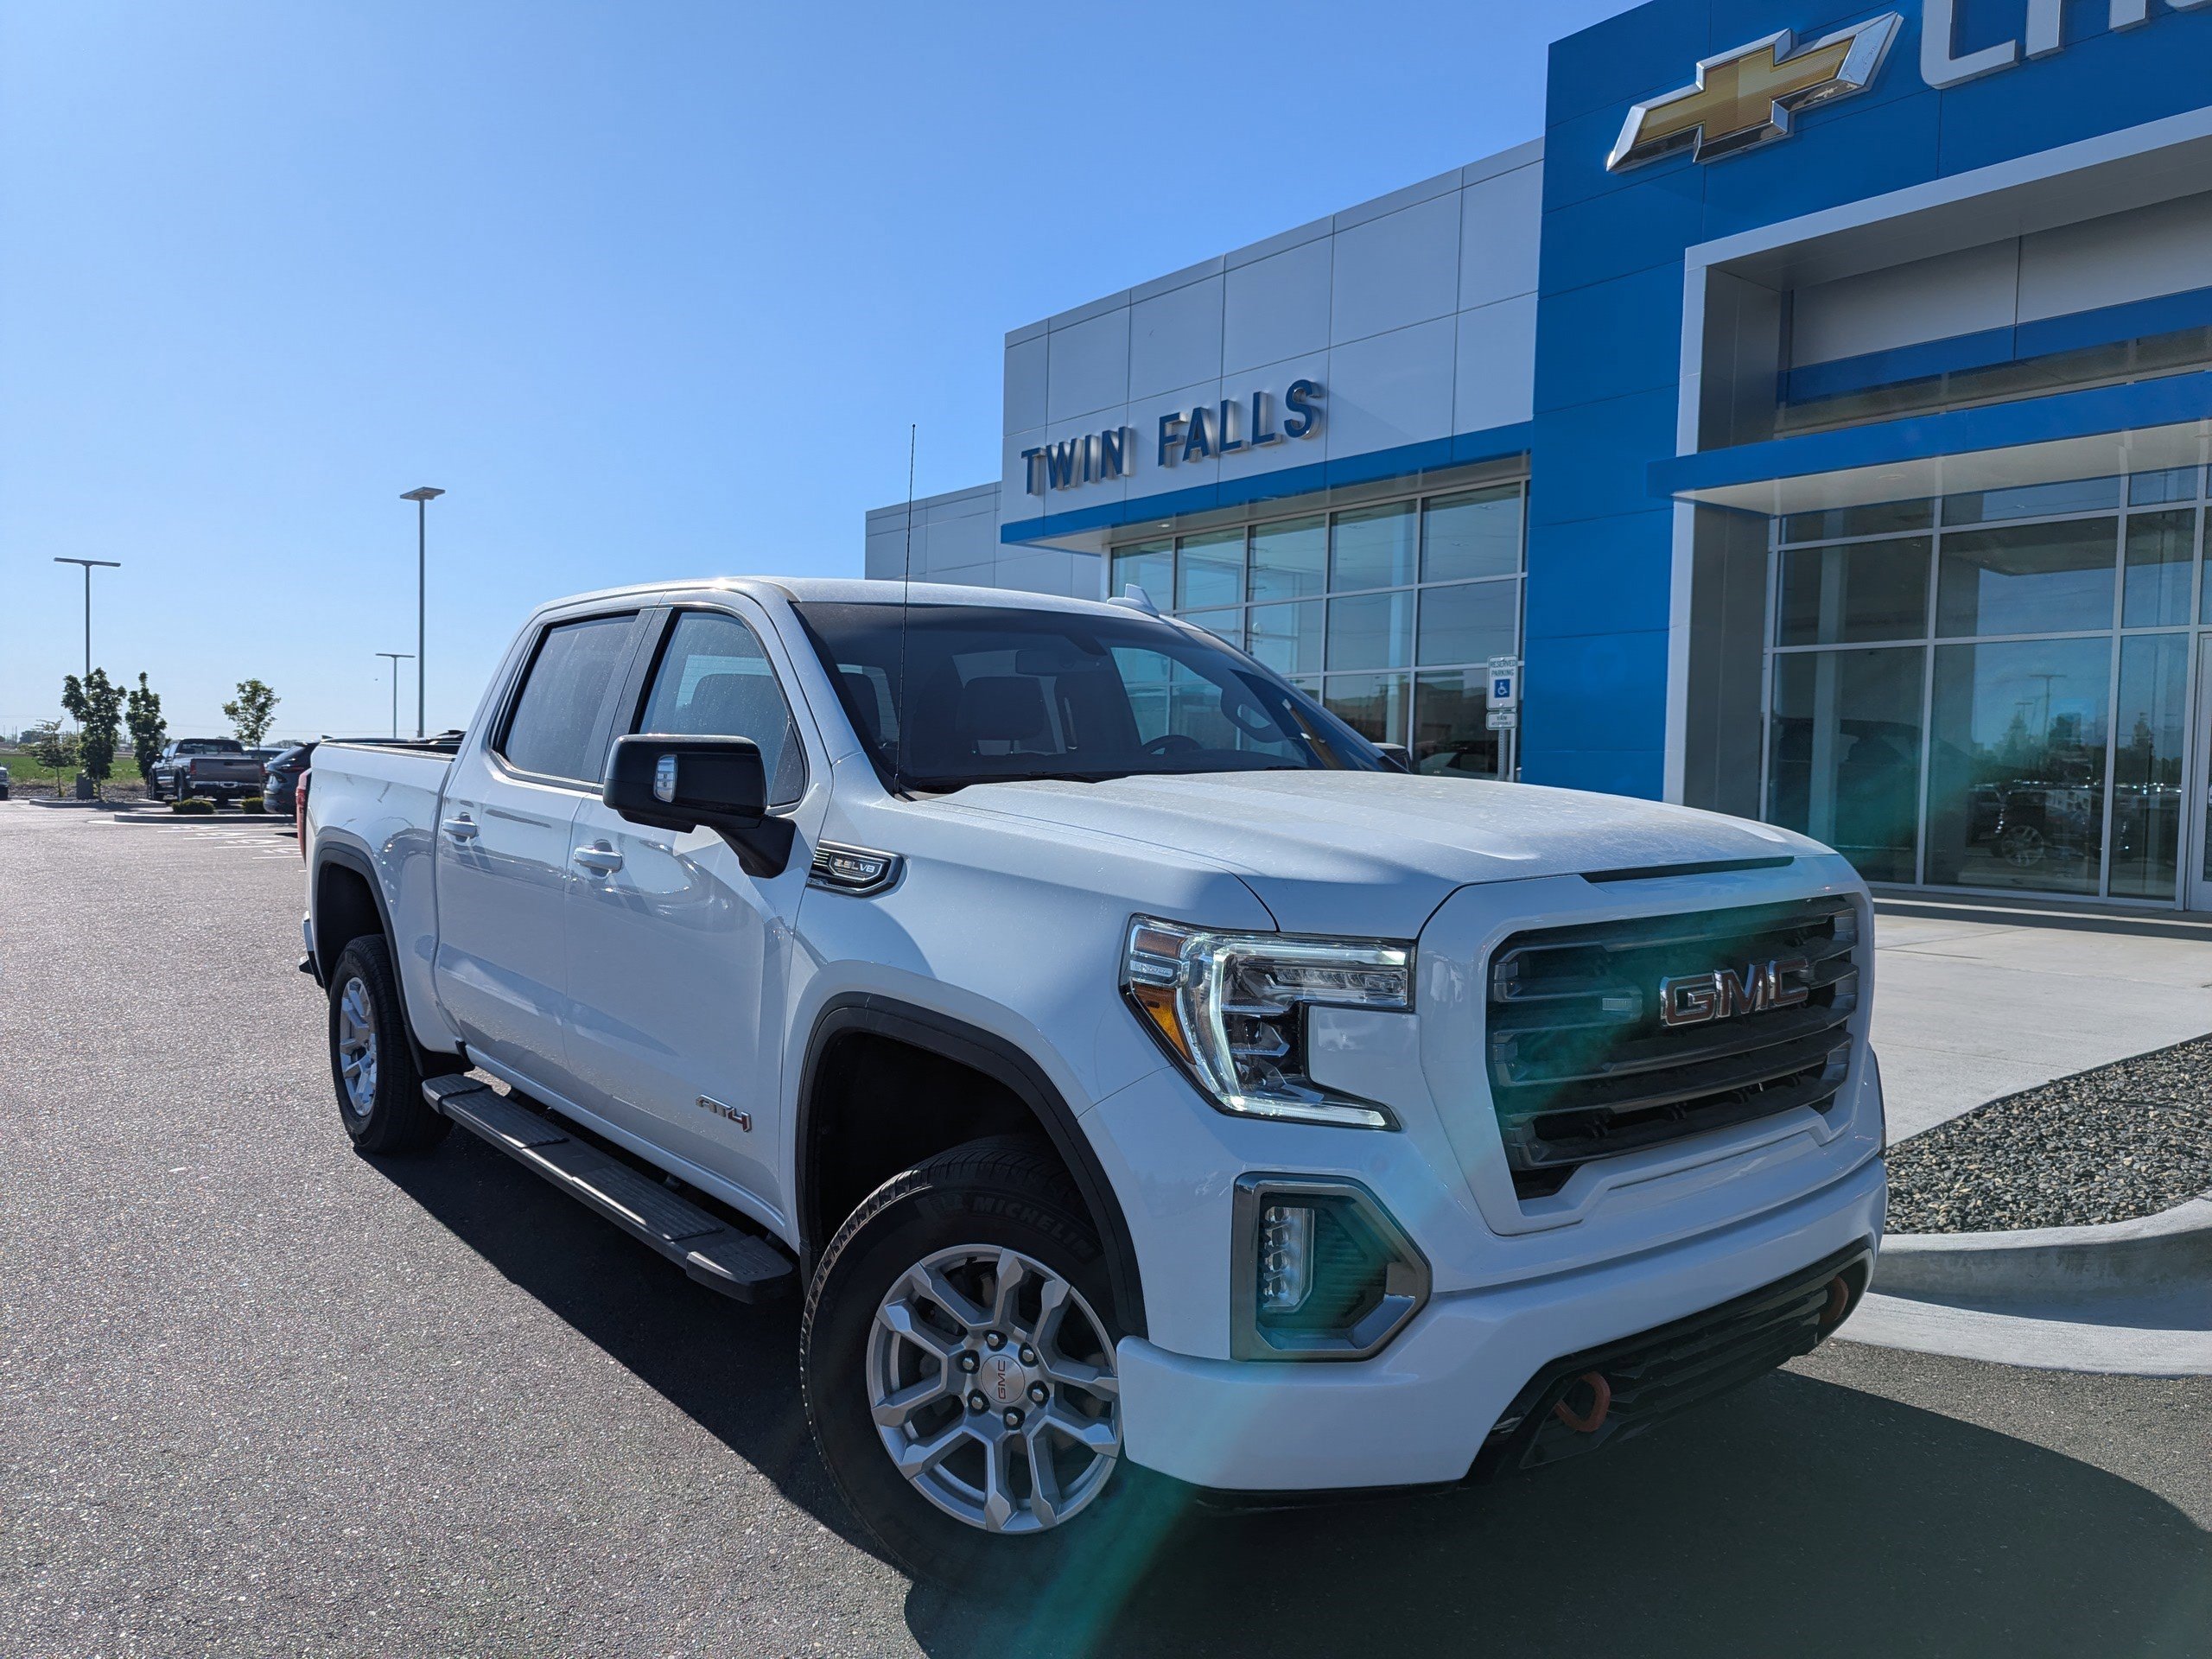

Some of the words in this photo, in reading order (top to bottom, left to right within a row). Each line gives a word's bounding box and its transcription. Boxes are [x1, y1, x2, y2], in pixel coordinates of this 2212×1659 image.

[1021, 426, 1135, 496] TWIN
[1157, 378, 1323, 467] FALLS
[1490, 659, 1516, 668] RESERVED
[1660, 956, 1809, 1027] GMC
[696, 1094, 752, 1133] AT4
[972, 1196, 1097, 1260] MICHELIN
[997, 1359, 1007, 1400] GMC
